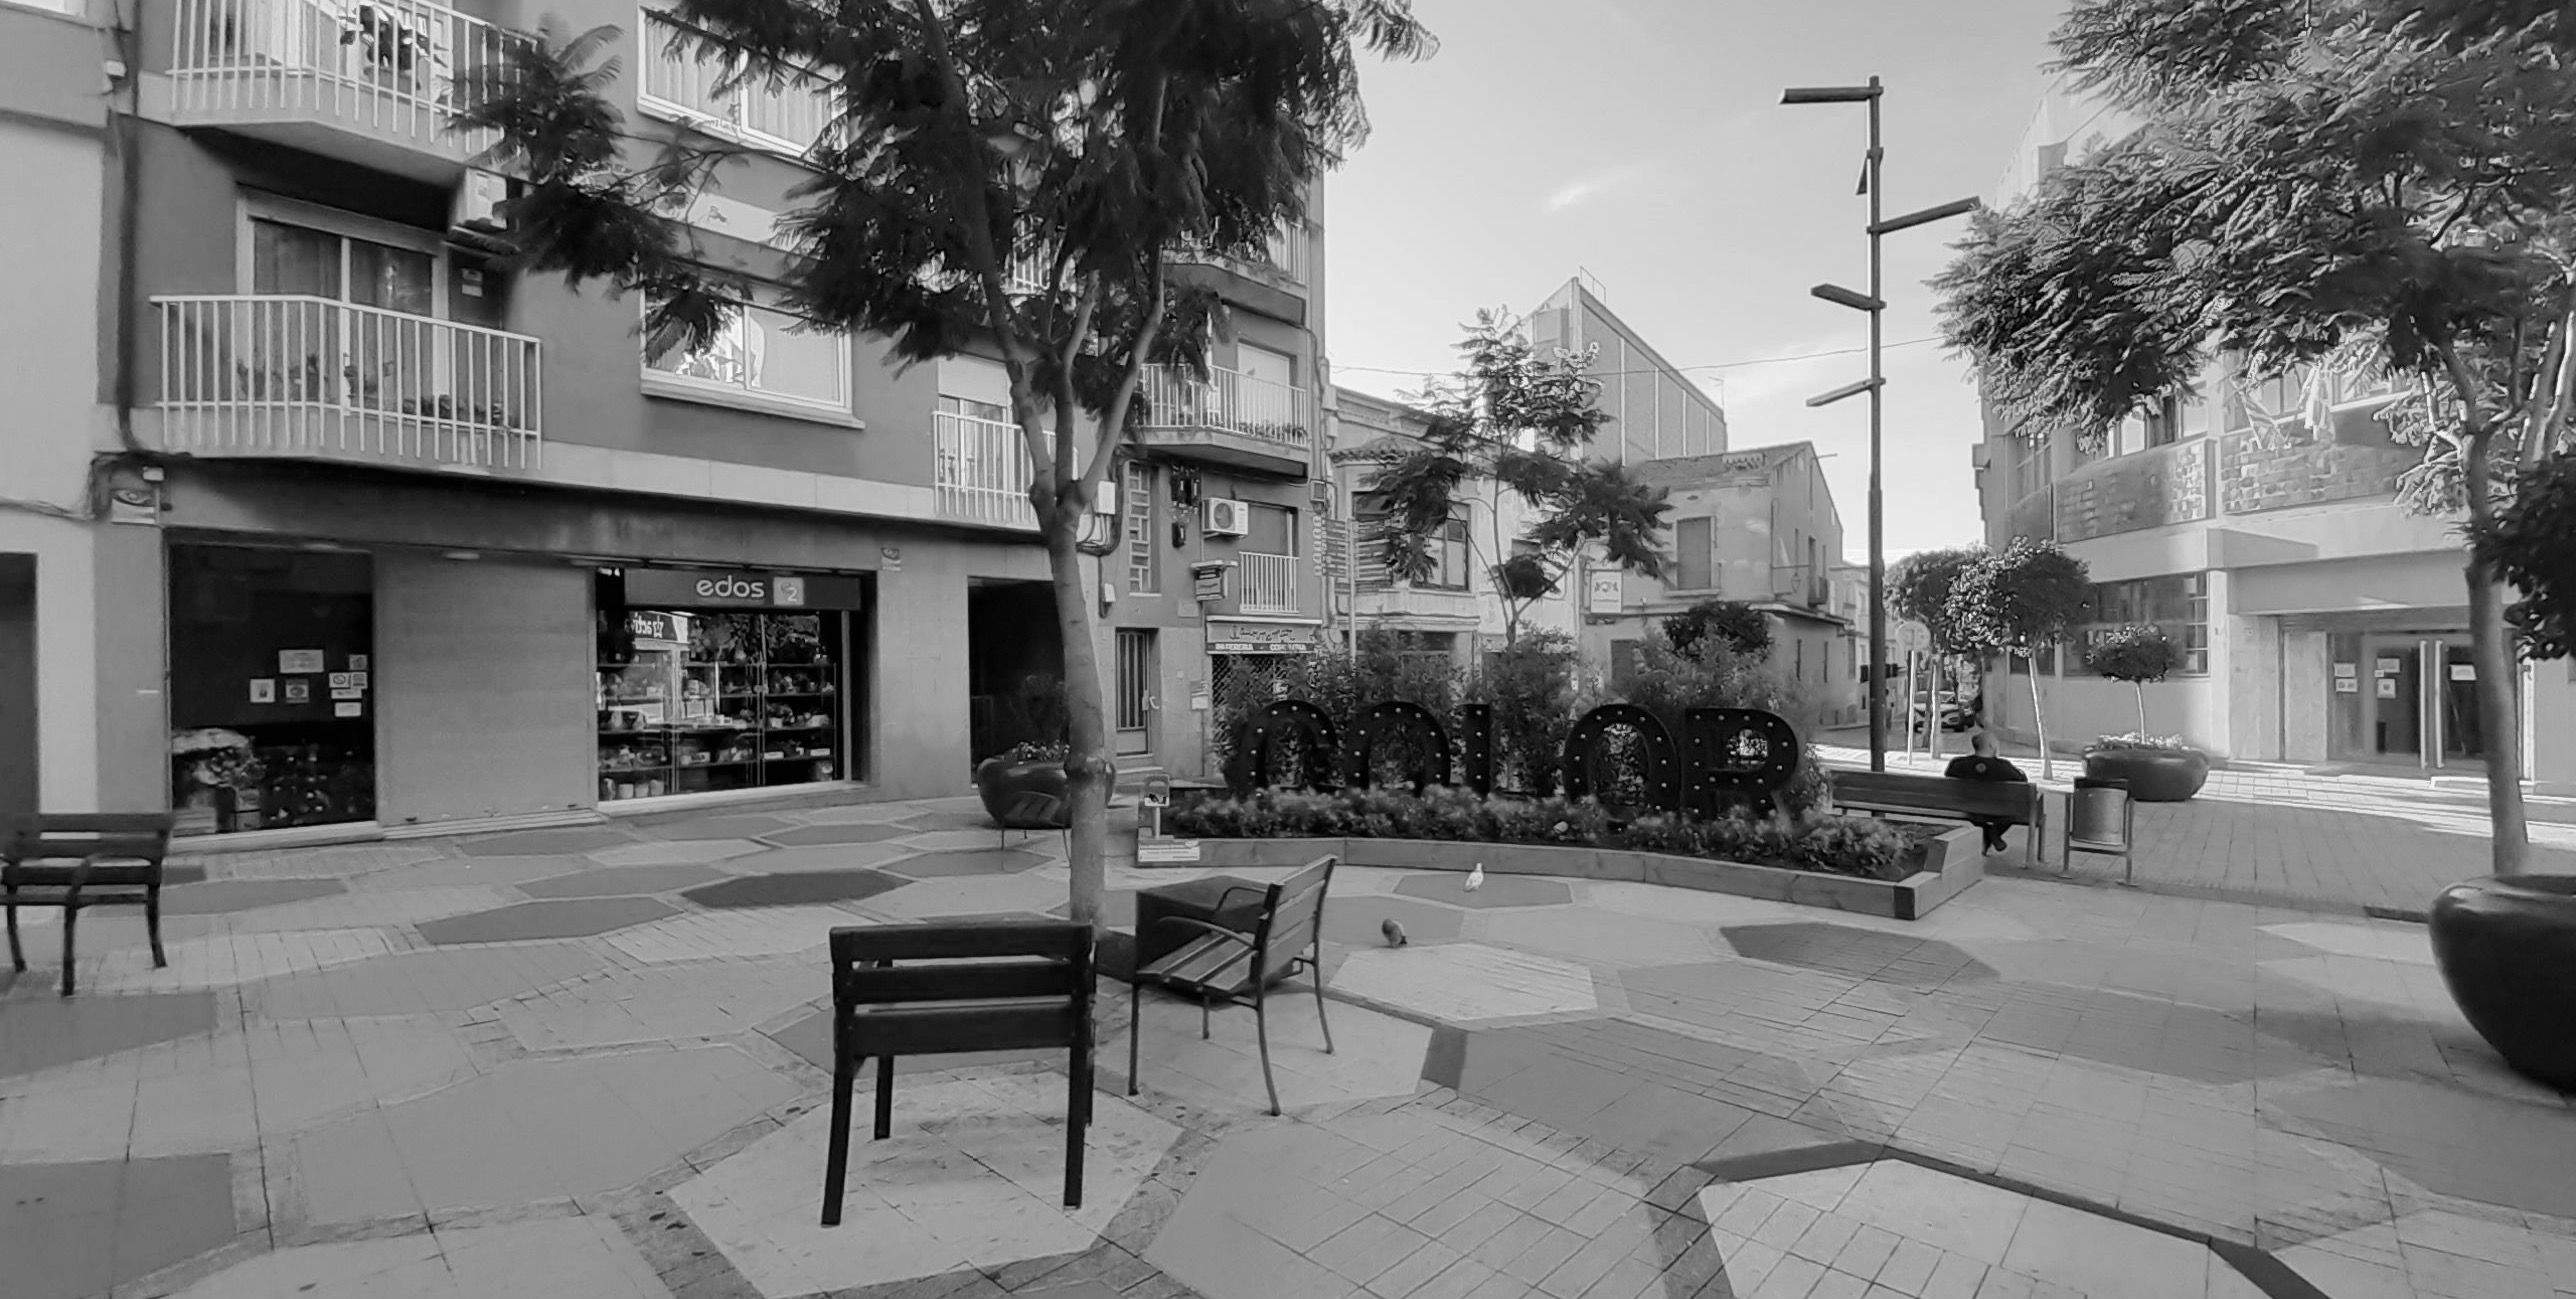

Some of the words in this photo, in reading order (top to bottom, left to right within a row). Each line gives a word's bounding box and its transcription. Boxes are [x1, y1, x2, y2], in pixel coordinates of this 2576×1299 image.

[695, 574, 765, 598] edos
[787, 586, 798, 602] 2
[1222, 700, 1799, 822] COLOR
